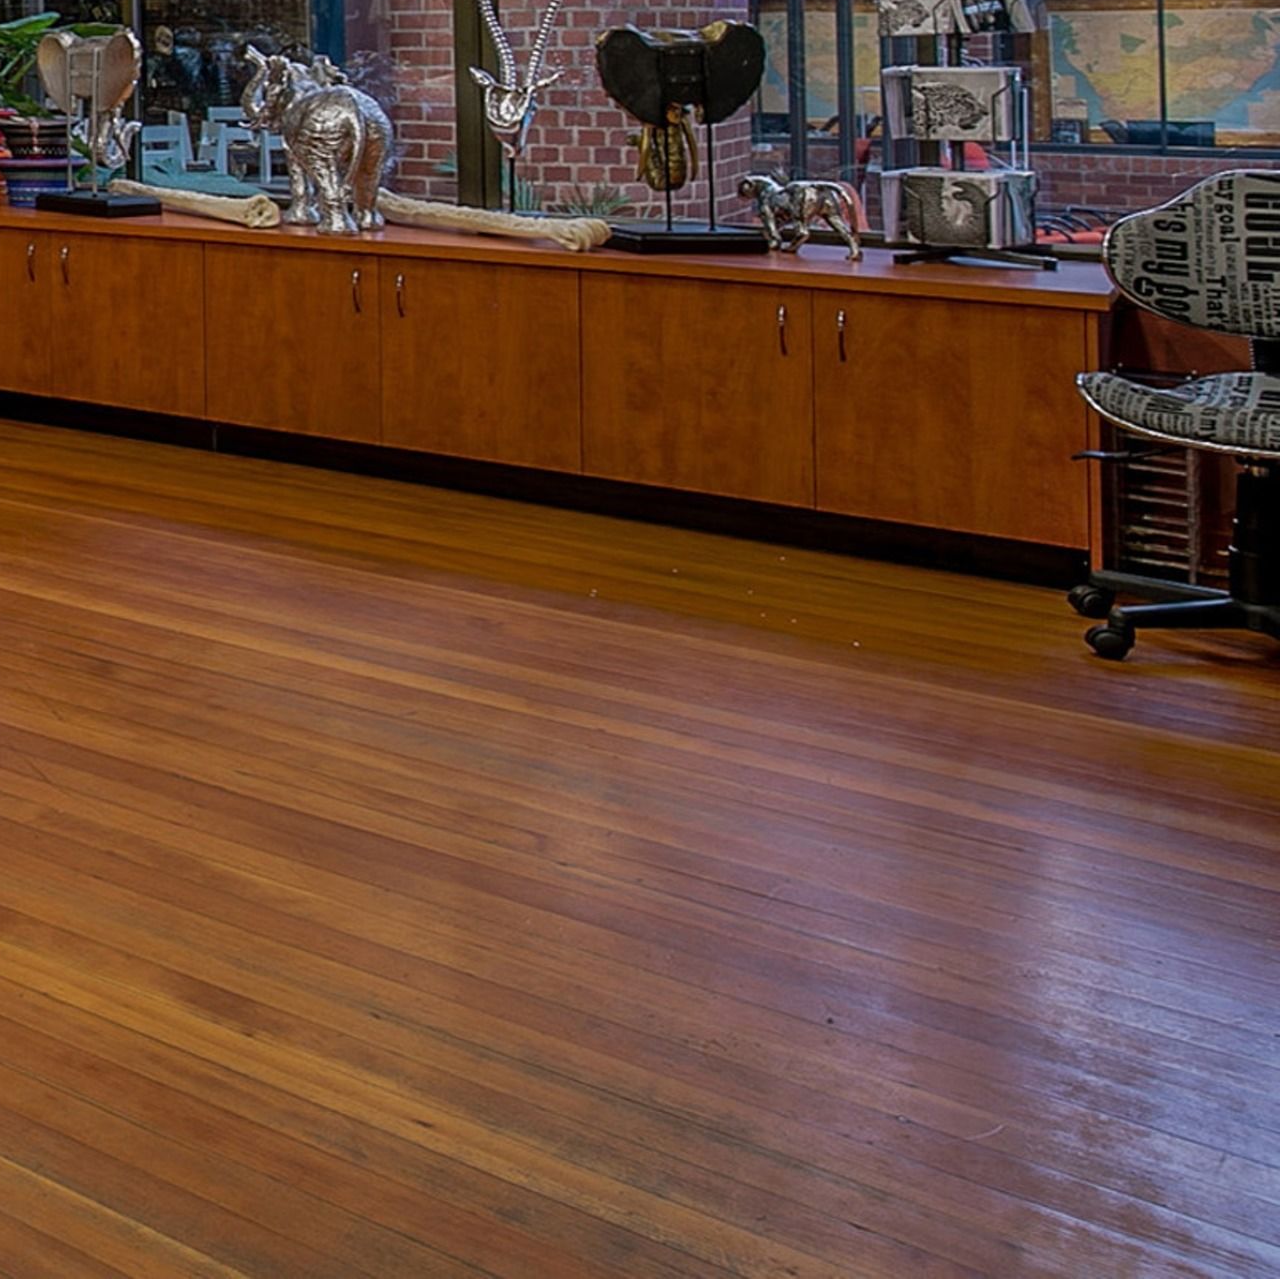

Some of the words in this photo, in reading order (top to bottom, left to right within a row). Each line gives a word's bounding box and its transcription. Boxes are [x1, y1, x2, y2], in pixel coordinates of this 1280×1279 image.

[1214, 178, 1235, 201] my
[1214, 203, 1241, 242] goal
[1143, 237, 1190, 277] my
